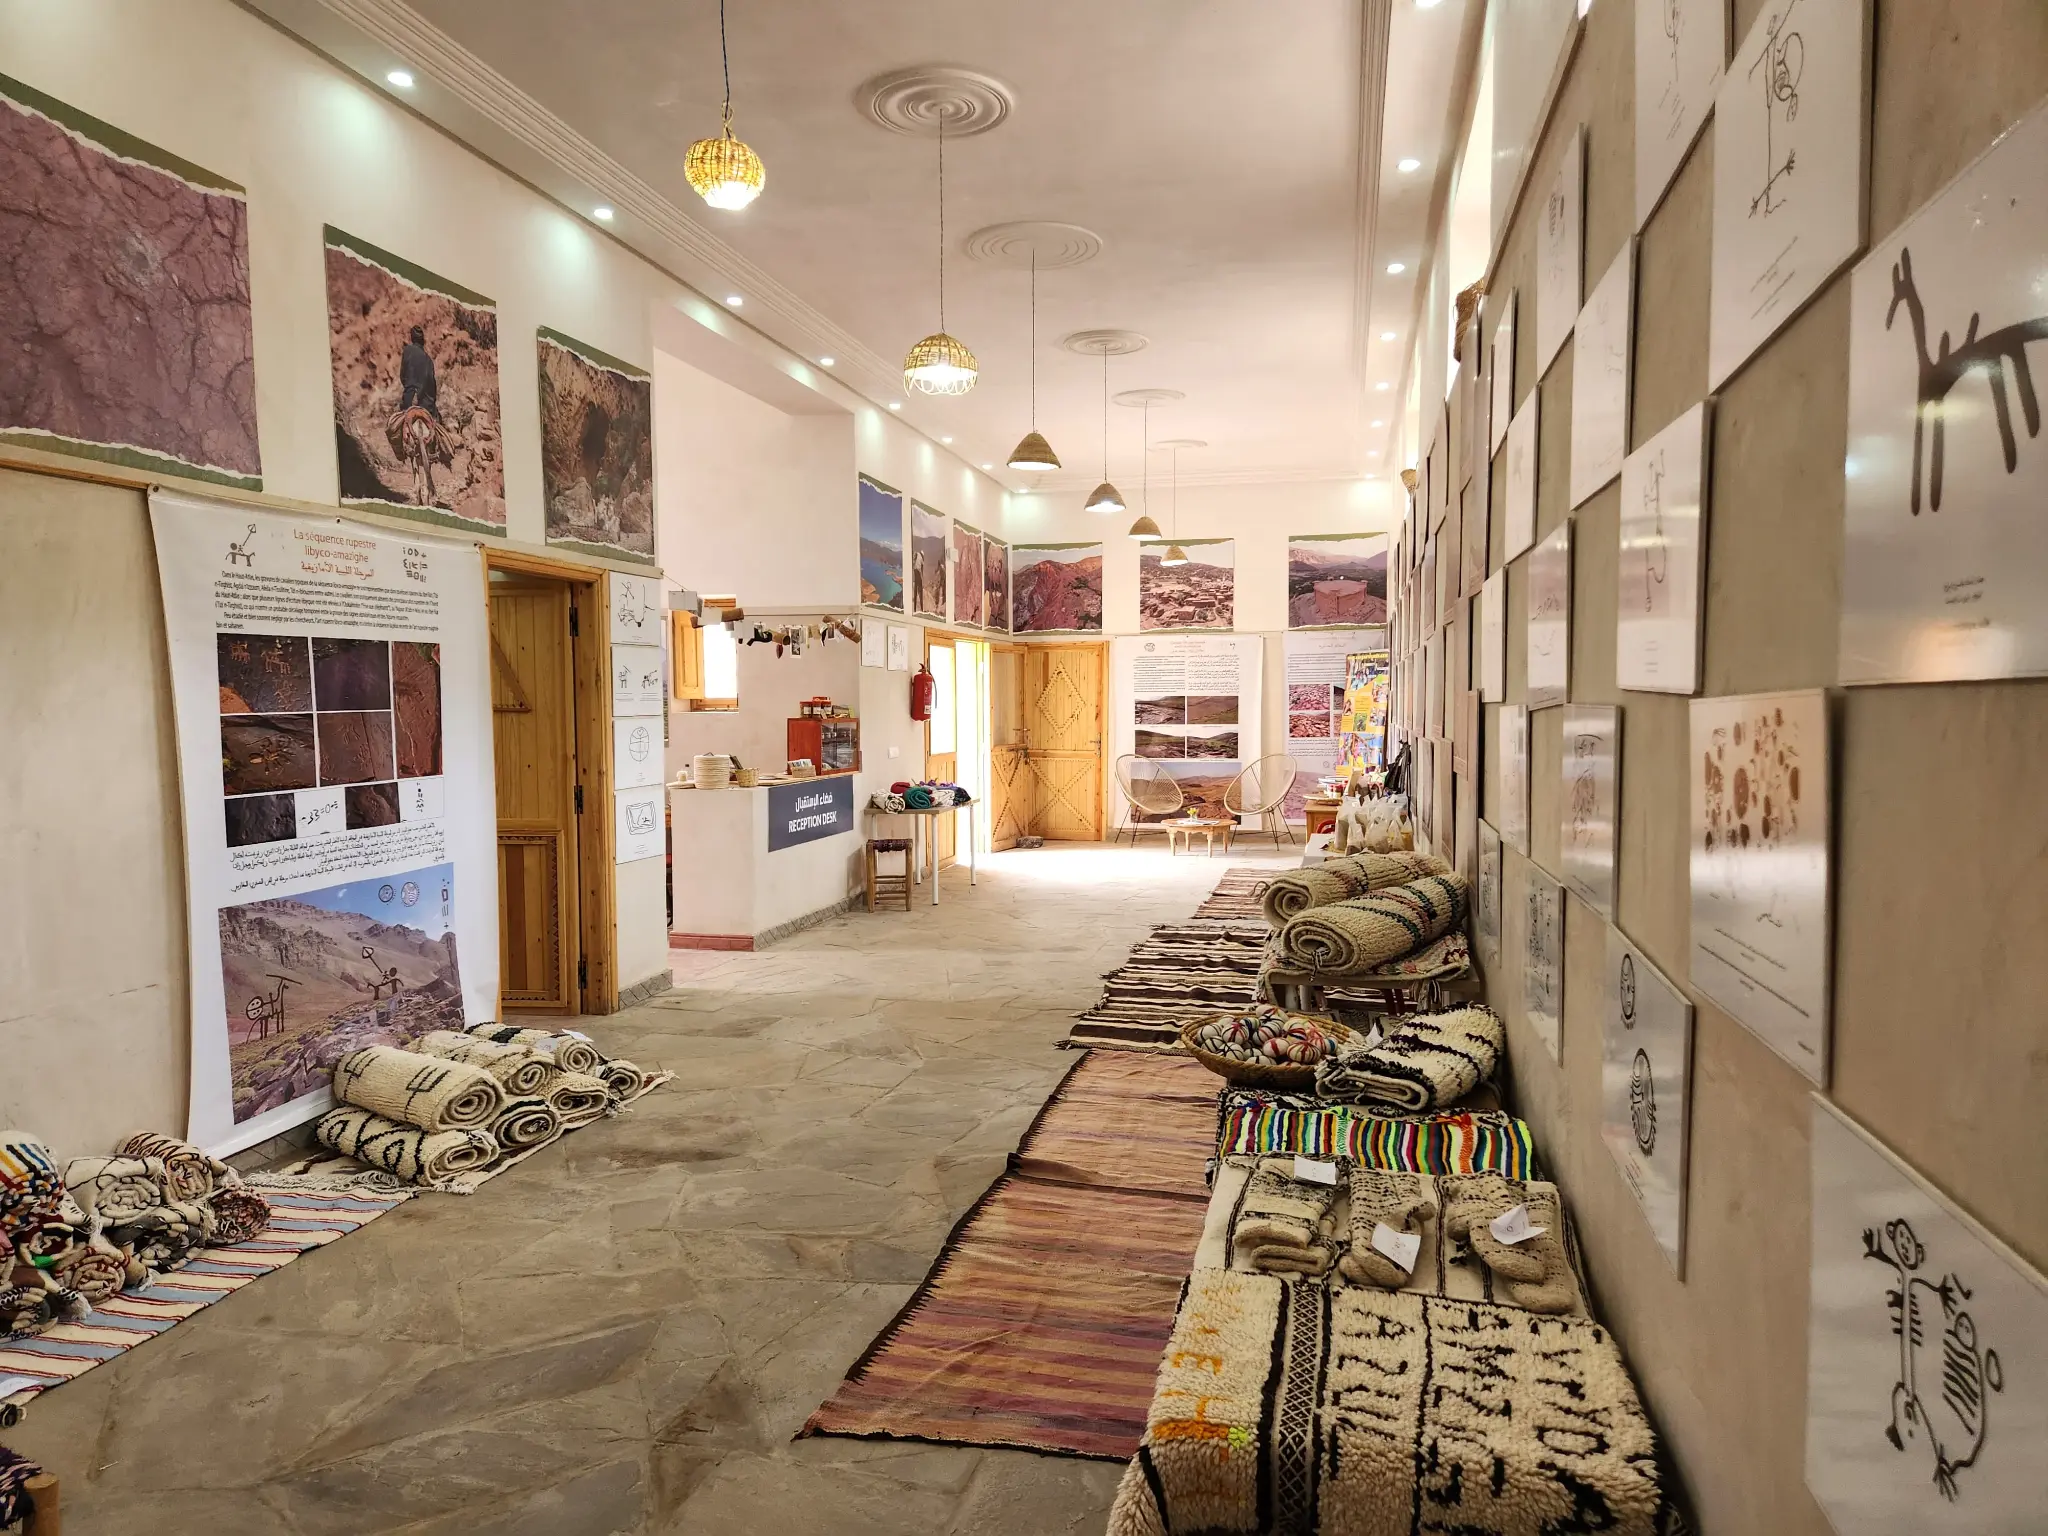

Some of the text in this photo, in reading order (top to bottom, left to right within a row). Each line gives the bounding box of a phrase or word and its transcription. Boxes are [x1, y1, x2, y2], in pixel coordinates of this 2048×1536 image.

[294, 528, 377, 550] La séquence rupestre
[305, 545, 369, 564] libyco-amazighe
[819, 791, 833, 806] فضاء
[788, 811, 837, 833] RECEPTION DESK
